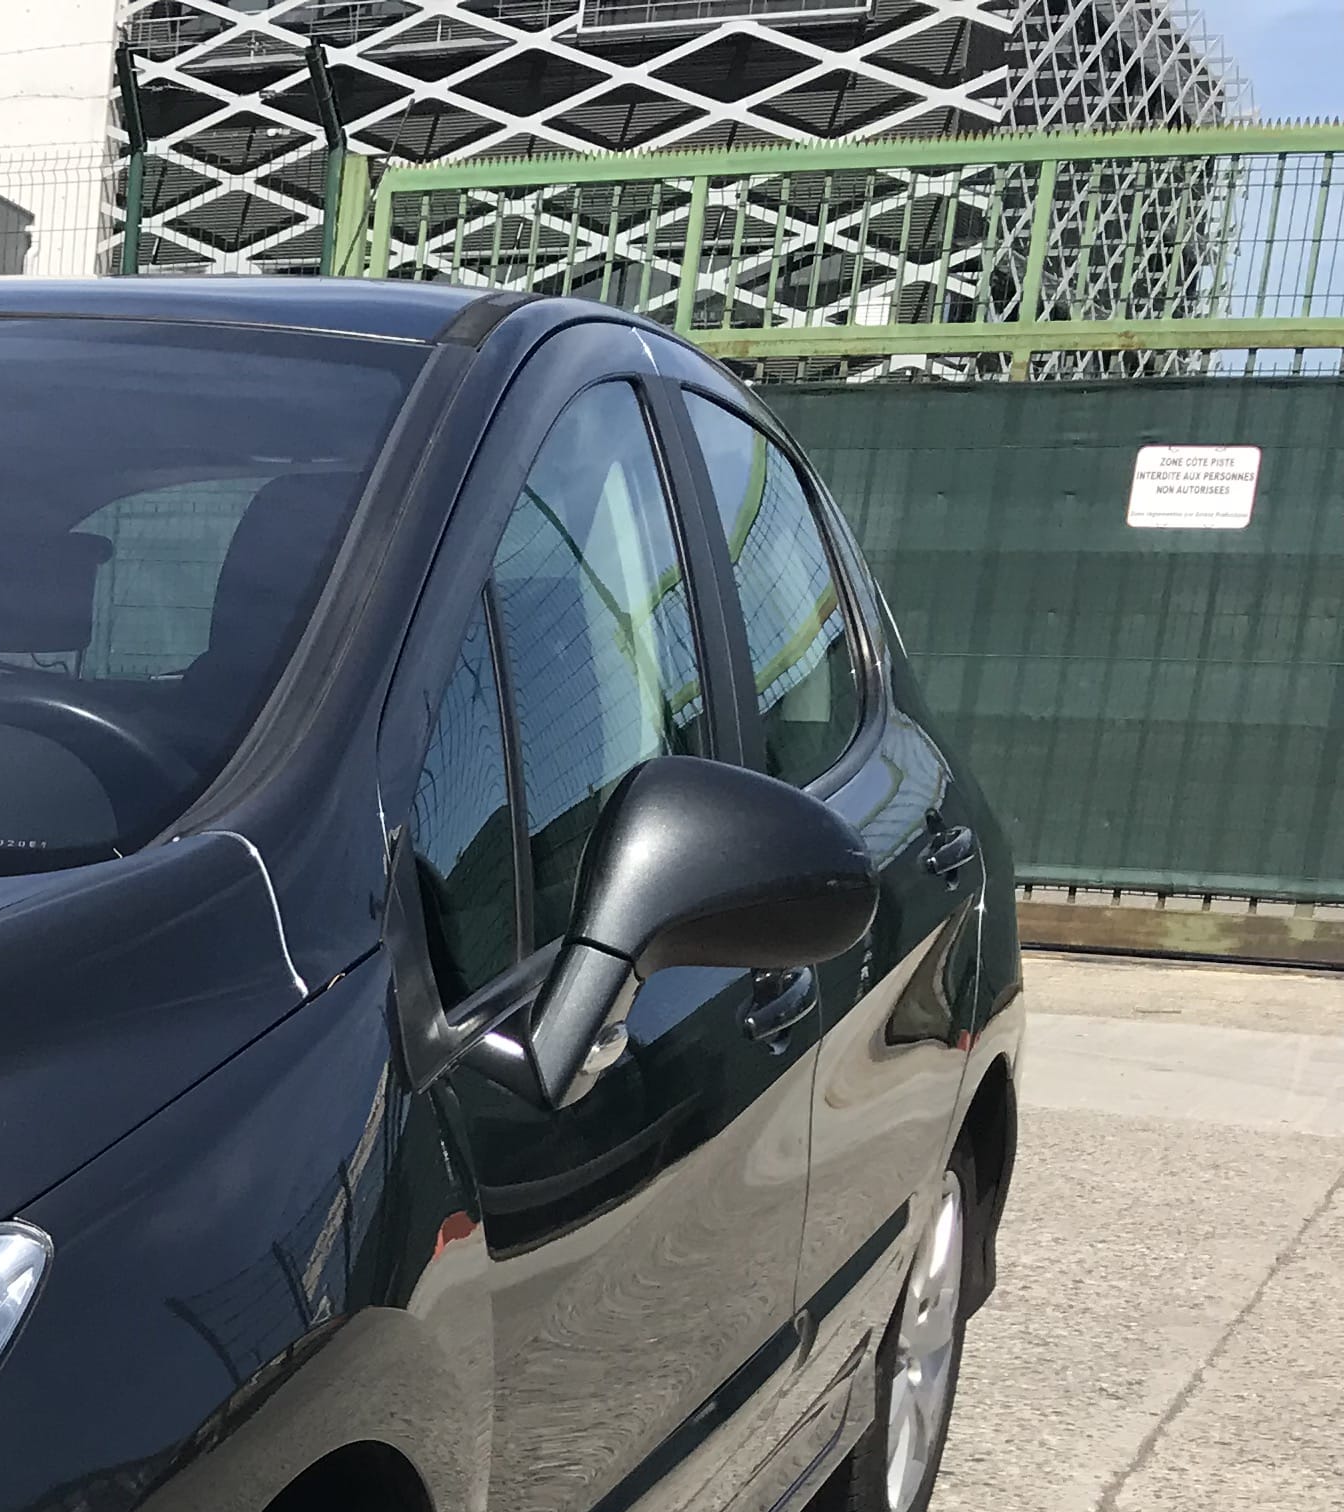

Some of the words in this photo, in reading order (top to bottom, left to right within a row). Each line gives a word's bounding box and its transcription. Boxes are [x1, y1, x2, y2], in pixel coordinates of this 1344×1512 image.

[1160, 457, 1183, 467] ZONE
[1211, 457, 1235, 467] PISTE
[1136, 471, 1180, 481] INTERDITE
[1183, 471, 1200, 481] AUX
[1203, 471, 1255, 482] PERSONNES
[1156, 485, 1174, 495] NON
